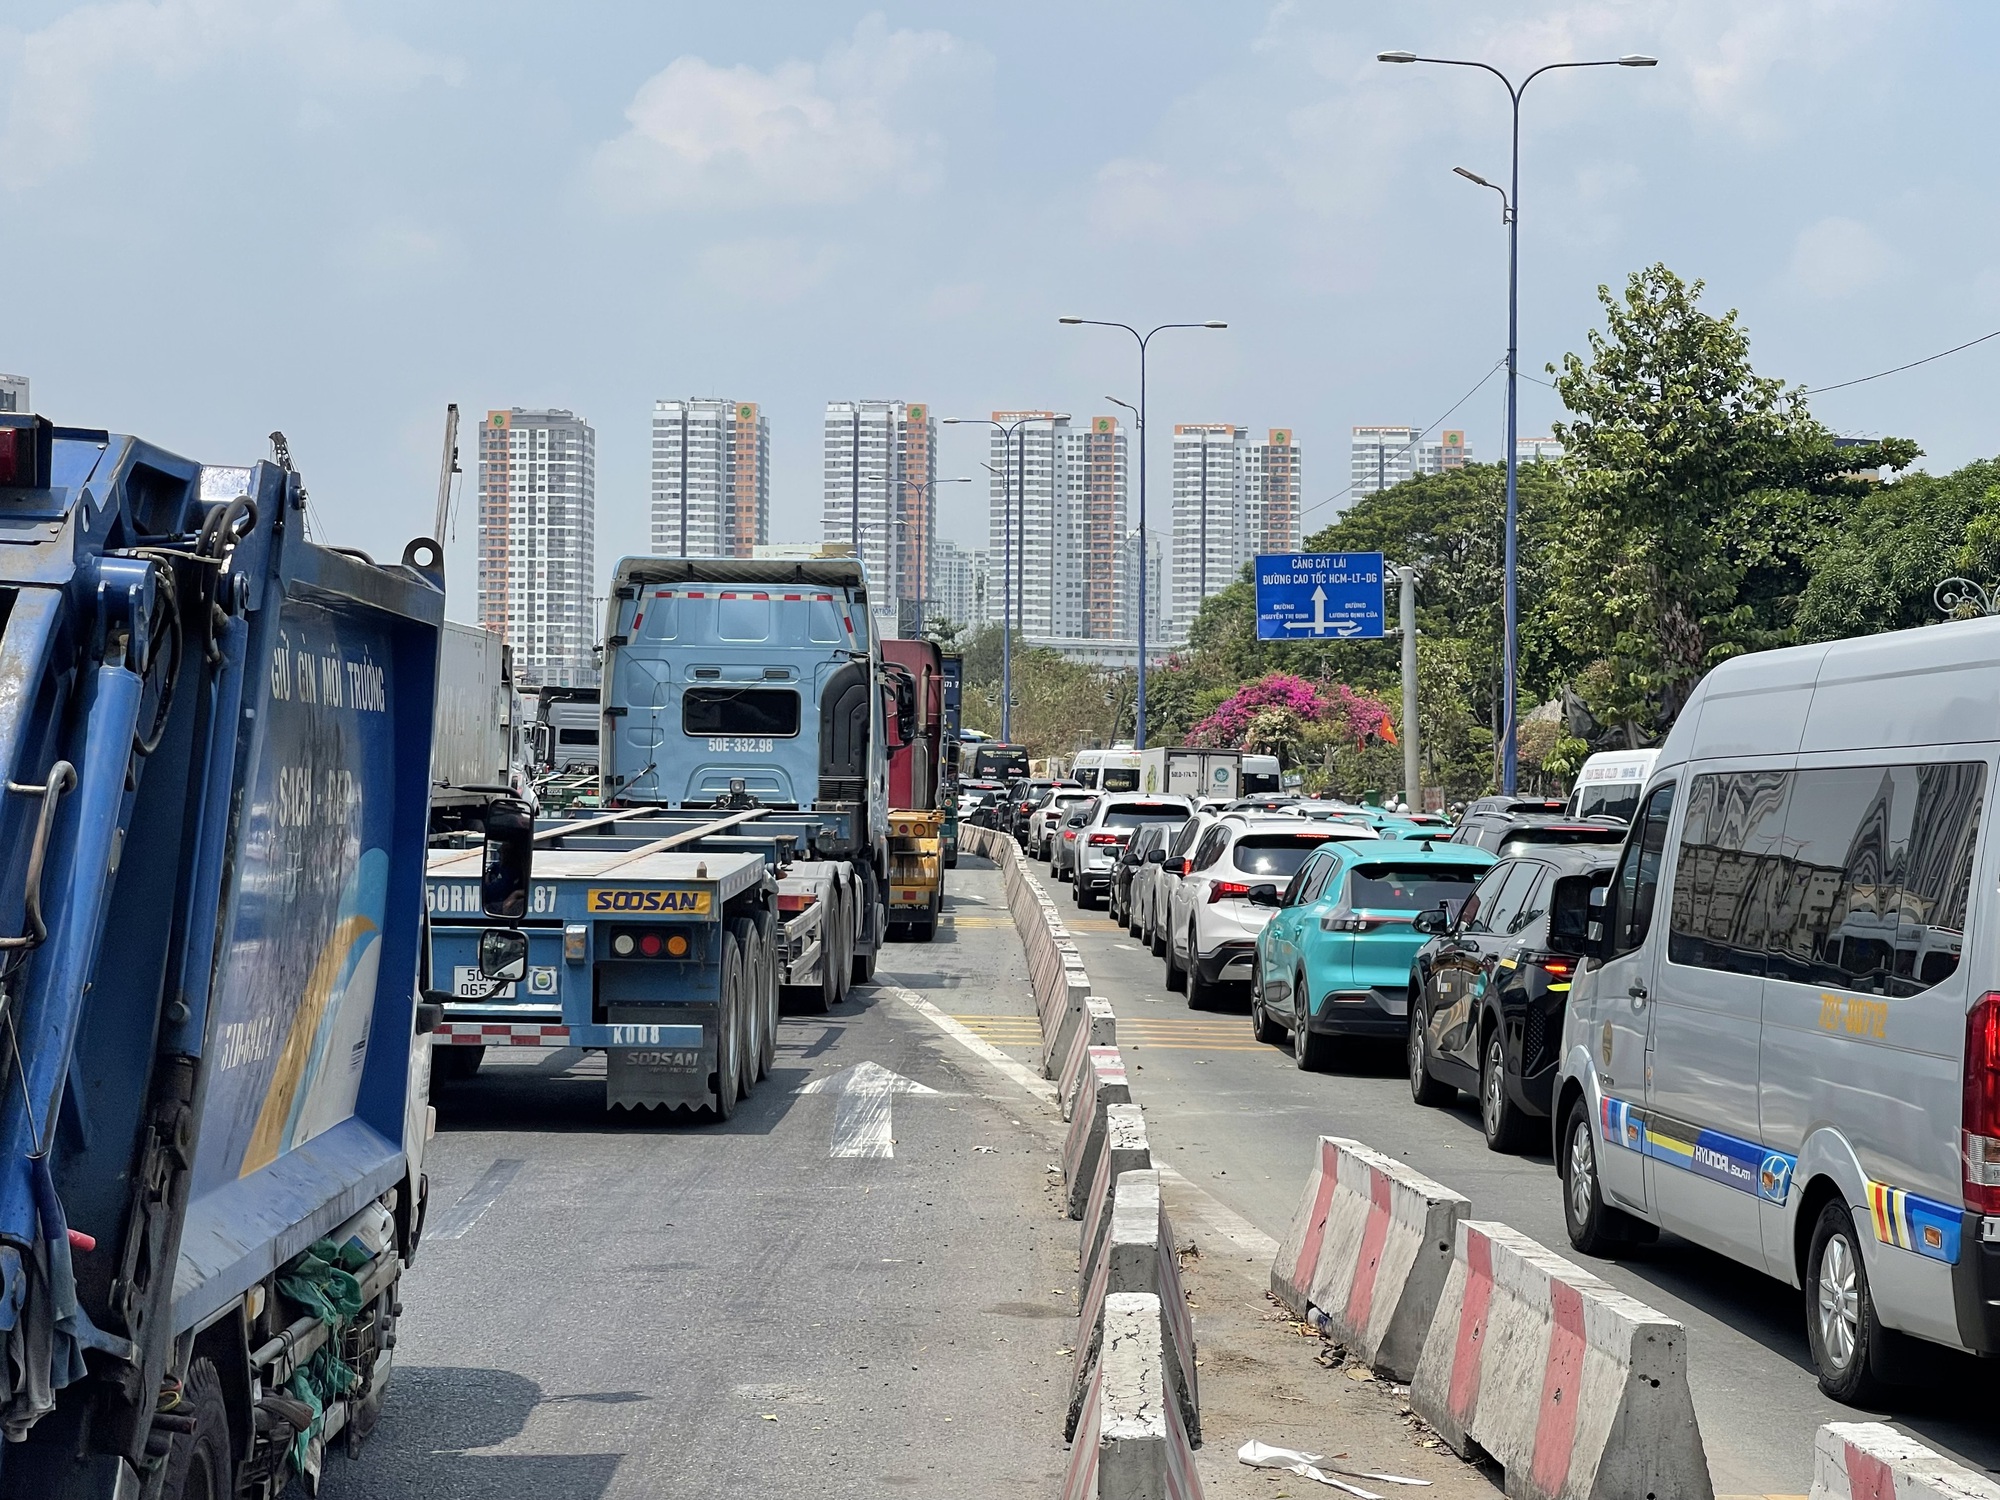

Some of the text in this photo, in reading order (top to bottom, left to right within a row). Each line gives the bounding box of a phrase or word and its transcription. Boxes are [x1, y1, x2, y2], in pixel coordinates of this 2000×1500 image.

[1292, 556, 1347, 569] CẢNG CÁT LÁI
[1262, 571, 1377, 585] ĐƯỜNG CAO TỐC HCM-LT-DG
[271, 629, 291, 701] GIỮ
[321, 643, 343, 707] MÔI
[346, 644, 385, 712] TRƯỜNG
[708, 738, 774, 753] 50E-332.98
[594, 891, 699, 912] SOOSAN
[613, 1026, 660, 1044] K008
[626, 1052, 699, 1066] SOOSAN
[1695, 1145, 1729, 1172] HYUNDAI
